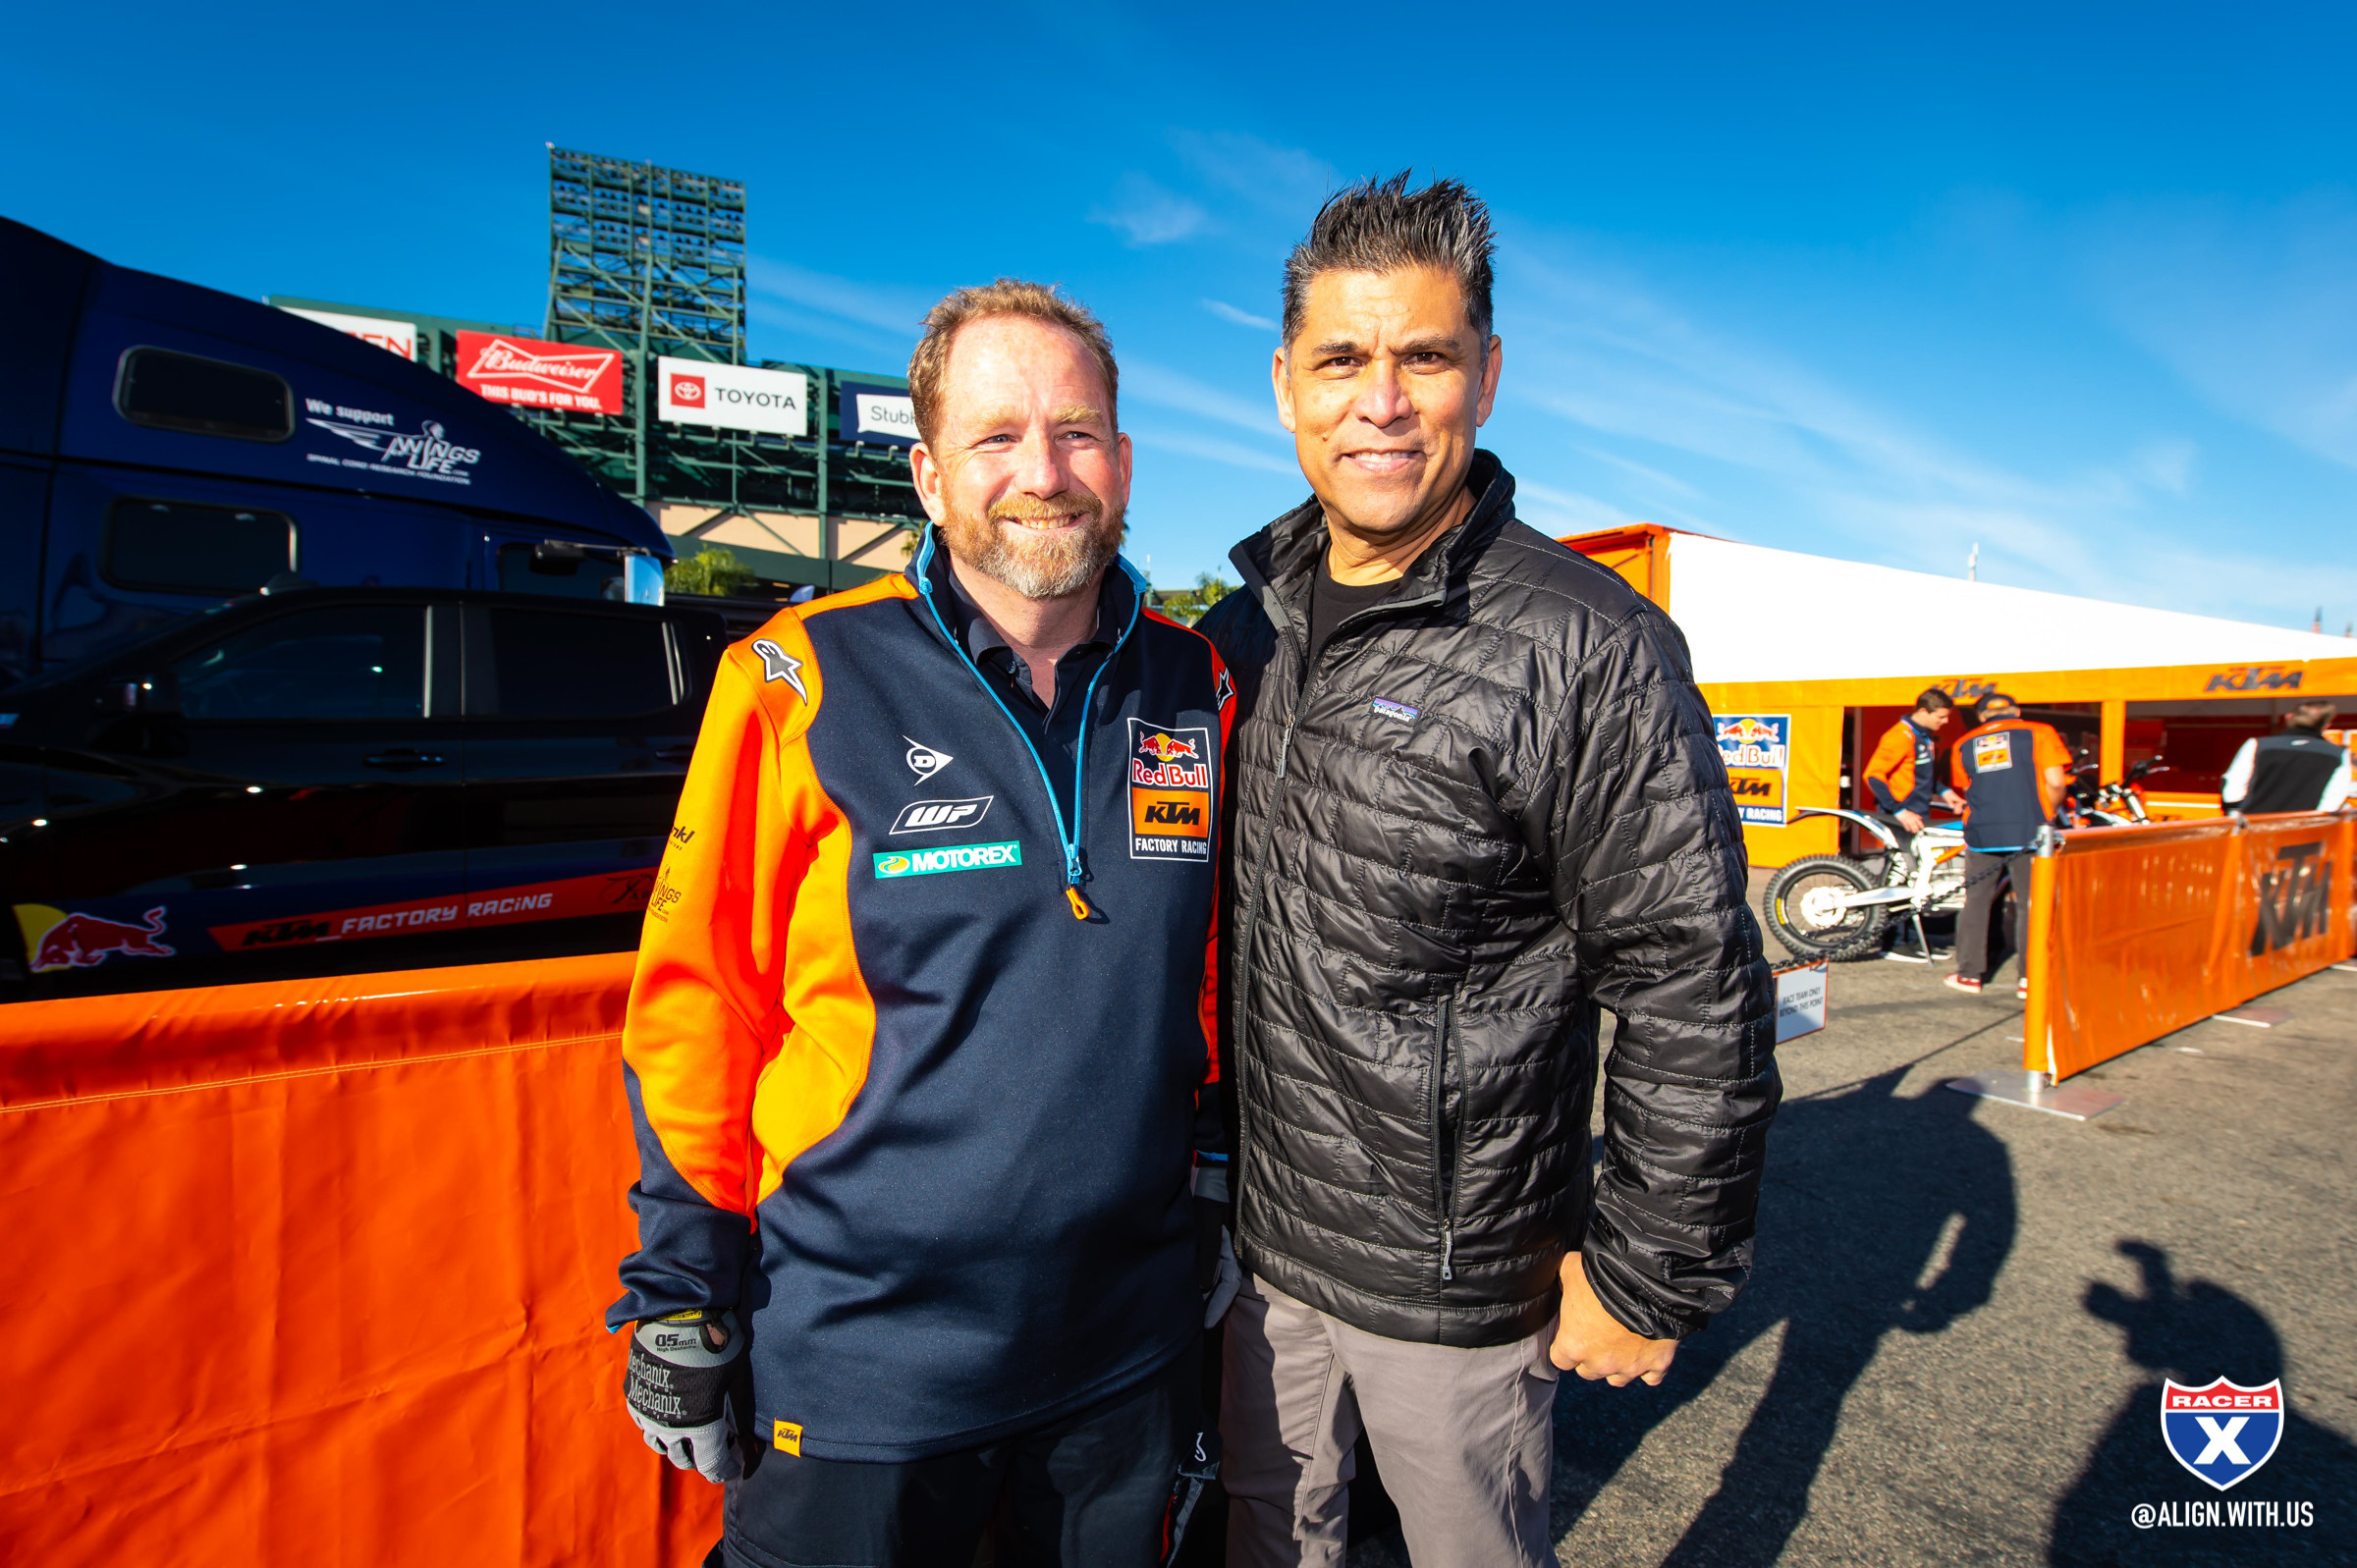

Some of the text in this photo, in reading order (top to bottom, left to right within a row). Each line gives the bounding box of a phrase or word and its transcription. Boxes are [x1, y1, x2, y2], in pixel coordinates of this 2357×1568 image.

[480, 347, 599, 380] Budweiser
[479, 384, 602, 410] THIS BUD'S FOR YOU.
[715, 387, 796, 410] TOYOTA
[305, 398, 395, 426] We support
[394, 435, 481, 464] WINGS
[407, 453, 458, 474] LIFE
[2204, 666, 2305, 693] KTM
[1373, 706, 1410, 723] patagonia
[1718, 743, 1785, 767] ed Bull
[1131, 757, 1209, 788] Red Bull
[904, 803, 978, 828] WP
[1144, 800, 1201, 826] KTM
[1746, 807, 1783, 822] RACING
[911, 844, 1016, 872] MOTOREX
[1134, 838, 1207, 854] FACTORY RACING
[2249, 840, 2333, 958] KTM
[242, 919, 330, 946] KTM
[1780, 997, 1824, 1017] BEYOND THIS POINT
[1783, 987, 1821, 1005] RACE TEAM ONLY
[627, 1375, 682, 1415] Mechanix
[776, 1427, 797, 1443] KTM
